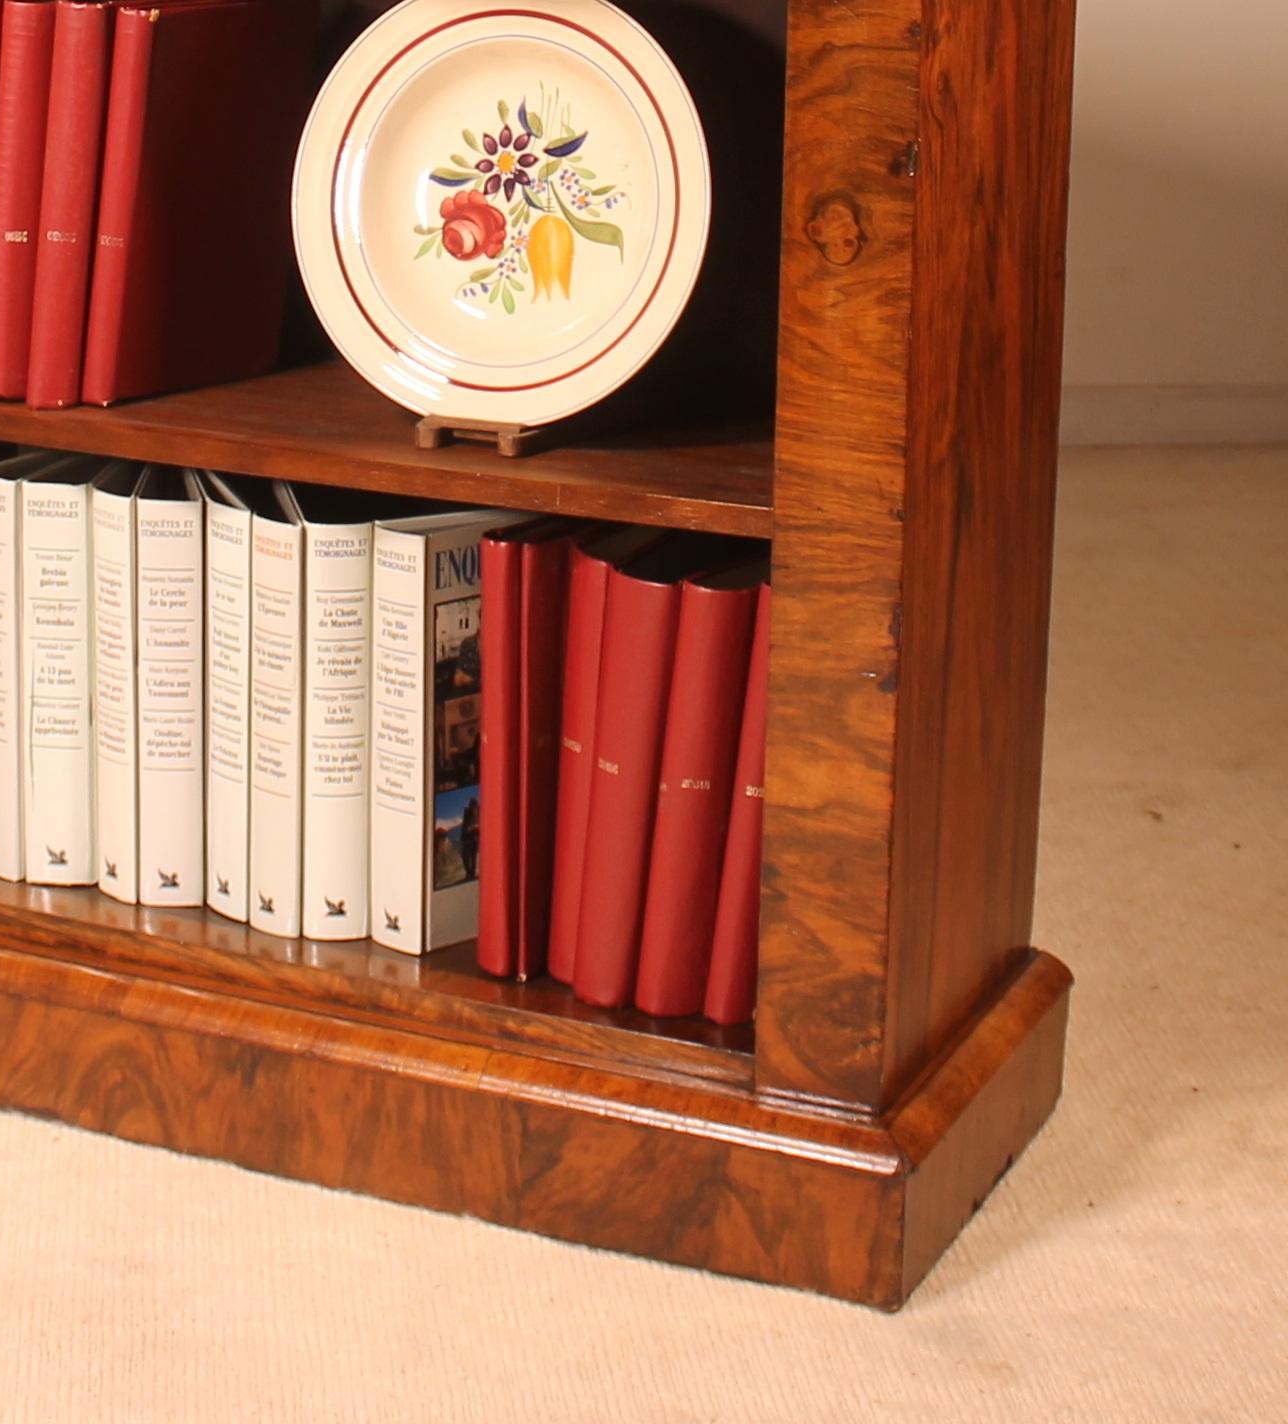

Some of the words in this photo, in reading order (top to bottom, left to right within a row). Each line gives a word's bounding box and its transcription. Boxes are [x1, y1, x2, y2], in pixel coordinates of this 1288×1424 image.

[27, 499, 66, 511] ENQUÊTES
[69, 500, 79, 509] ET
[27, 508, 80, 519] TÉMOIGNAGES
[140, 518, 181, 529] ENQUÊTES
[183, 519, 194, 529] ET
[140, 528, 194, 538] TÉMOIGNAGES
[314, 538, 356, 549] ENQUÊTES
[358, 538, 367, 547] ET
[314, 547, 368, 558] TÉMOIGNAGES
[323, 608, 333, 617] La
[318, 619, 328, 628] de
[330, 617, 363, 628] Maxwell
[327, 705, 338, 715] La
[340, 704, 353, 715] Vie
